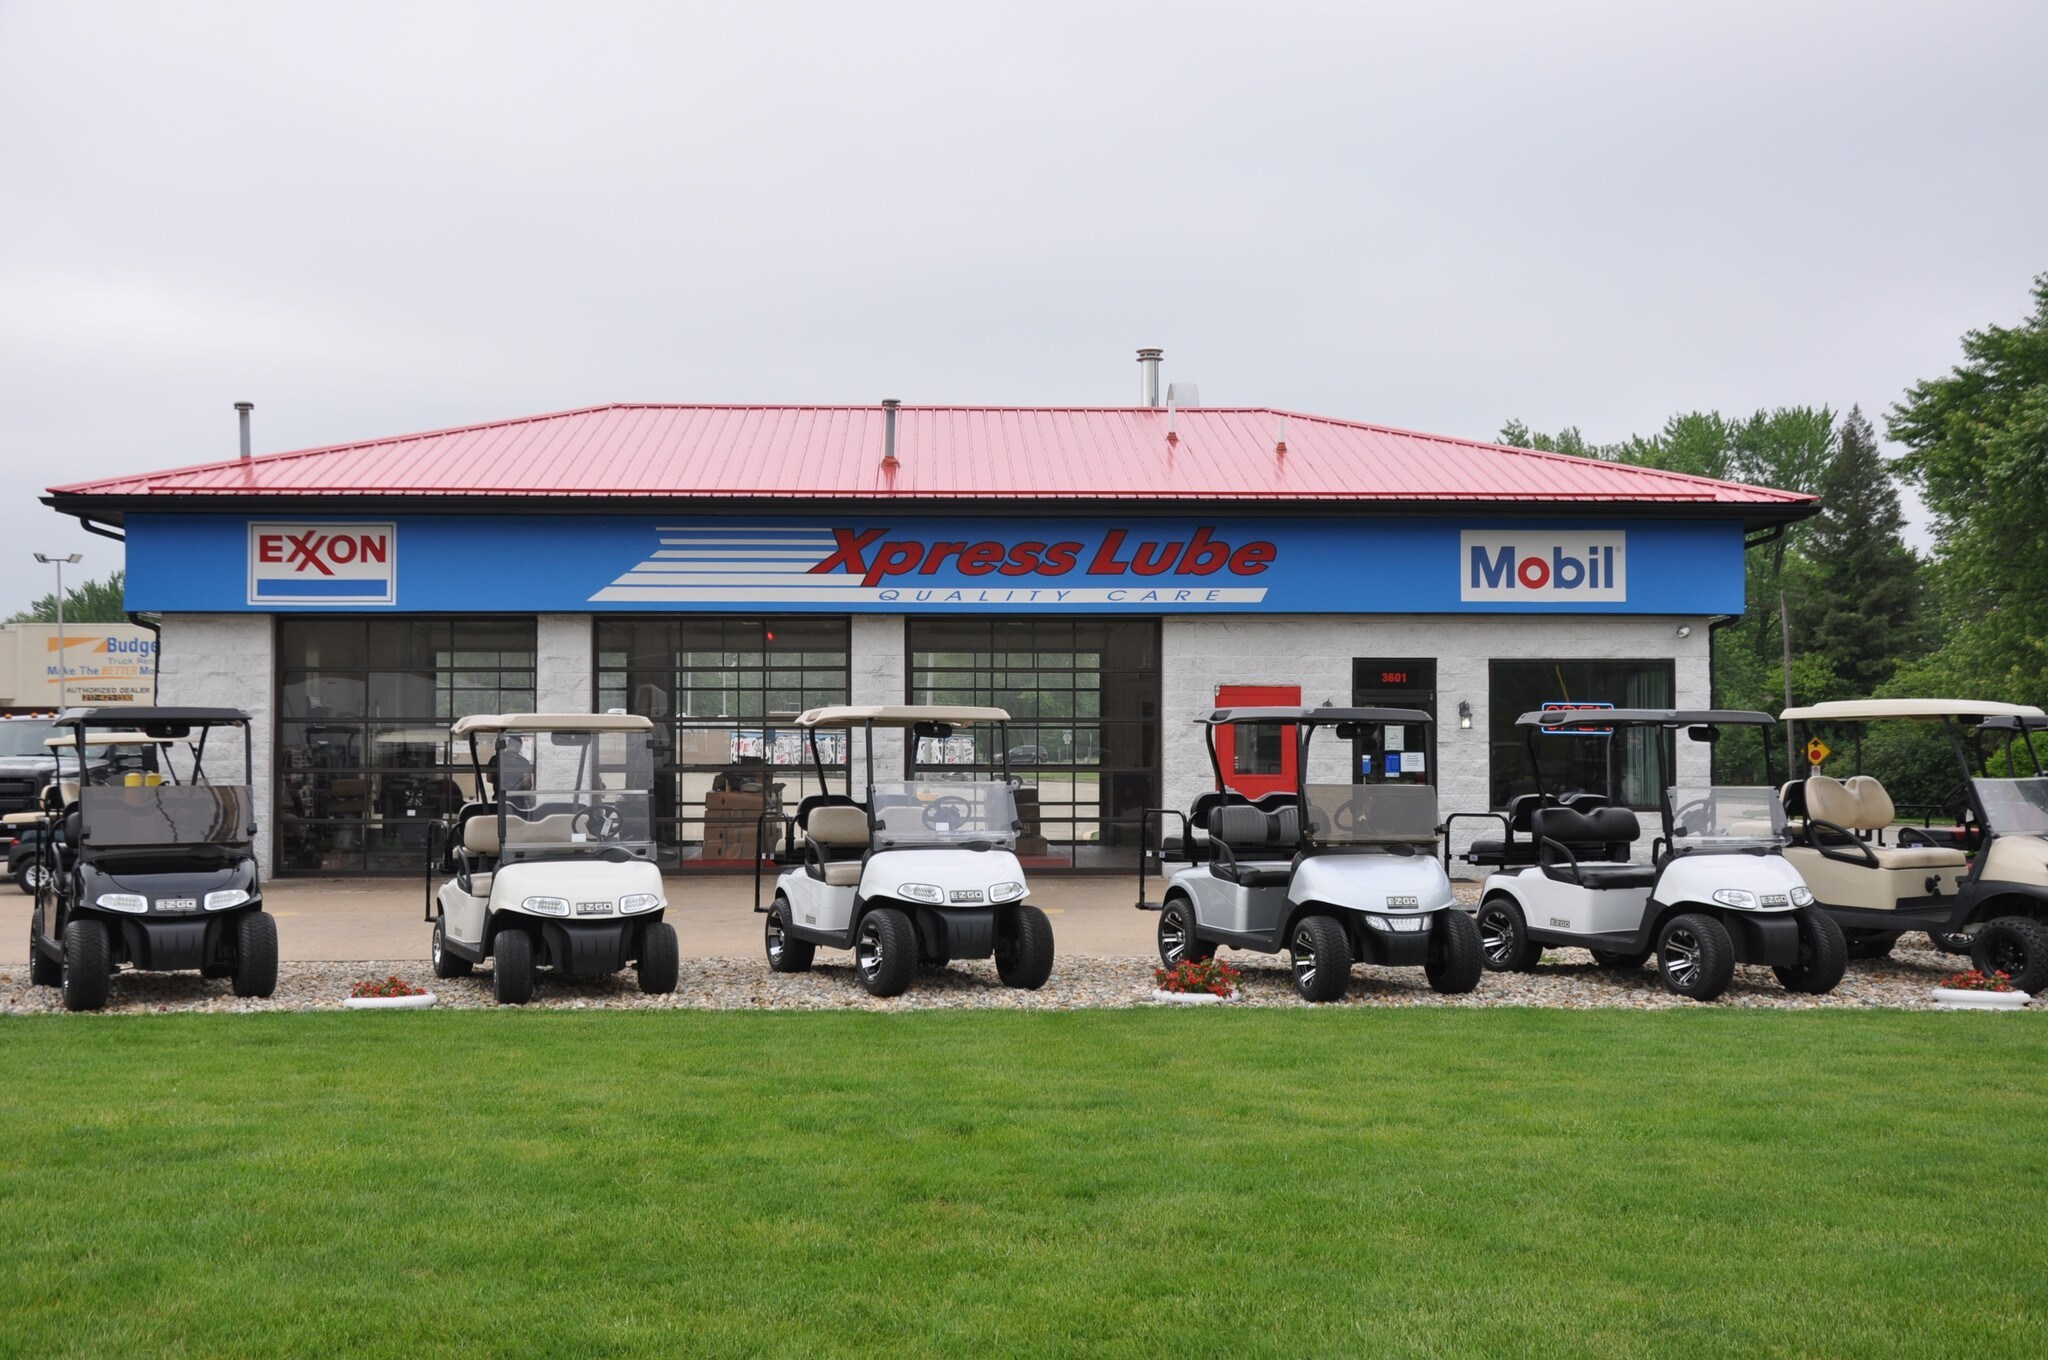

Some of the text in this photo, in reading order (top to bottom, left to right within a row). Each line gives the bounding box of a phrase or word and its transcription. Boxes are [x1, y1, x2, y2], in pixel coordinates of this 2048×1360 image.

[258, 530, 387, 576] EXXON
[804, 527, 1278, 588] Xpress Lube
[1470, 546, 1614, 590] Mobil
[878, 589, 1220, 602] QUALITY CARE
[80, 666, 99, 675] The
[102, 666, 138, 675] BETTER
[1381, 672, 1408, 683] 3601
